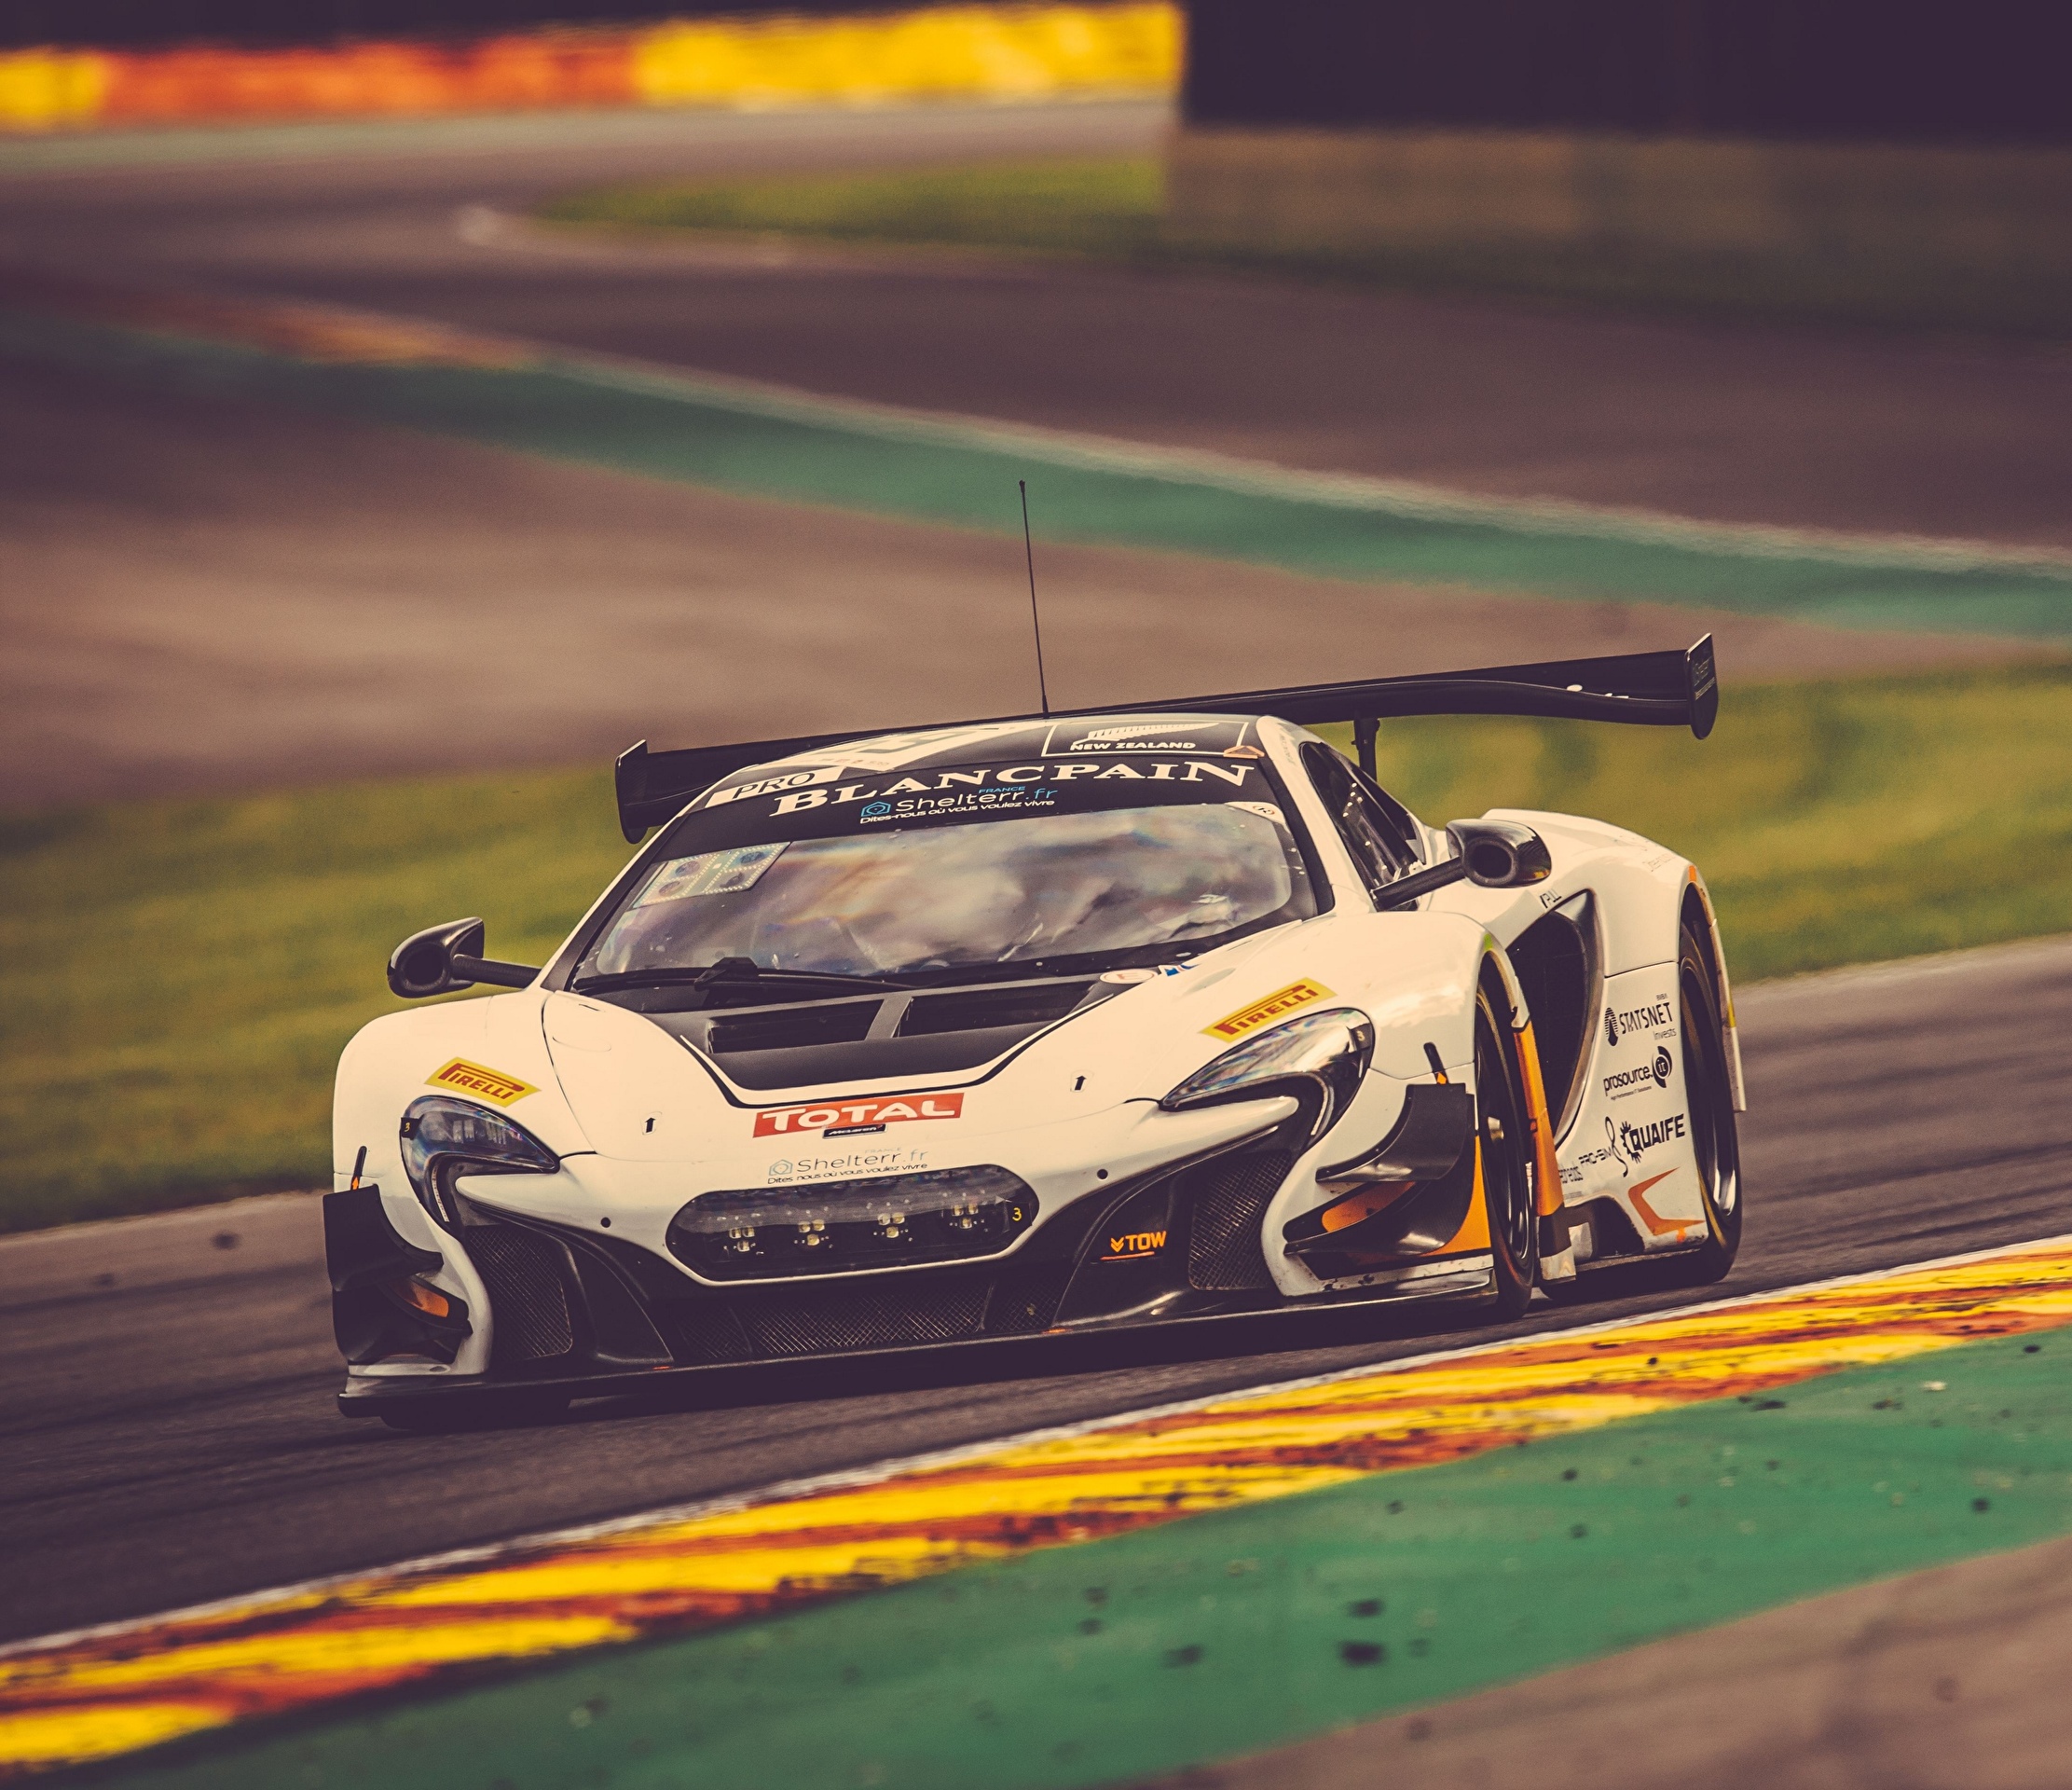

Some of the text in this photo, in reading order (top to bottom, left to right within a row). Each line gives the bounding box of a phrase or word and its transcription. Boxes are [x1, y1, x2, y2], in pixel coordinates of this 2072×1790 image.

[1070, 741, 1197, 750] NEW ZEALAND
[732, 773, 816, 799] PRO
[769, 762, 1255, 817] BLANCPAIN
[896, 788, 1058, 812] Shelterr.fr
[948, 805, 978, 813] vous
[1213, 984, 1319, 1036] PIRELLI
[1619, 1002, 1673, 1034] STATSNET
[437, 1062, 525, 1099] PIRELLI
[404, 1122, 411, 1133] 3
[762, 1100, 955, 1132] TOTAL
[829, 1126, 877, 1136] McLaren
[1628, 1113, 1685, 1152] QUAIFE
[1012, 1207, 1022, 1221] 3
[1125, 1231, 1167, 1251] TOW
